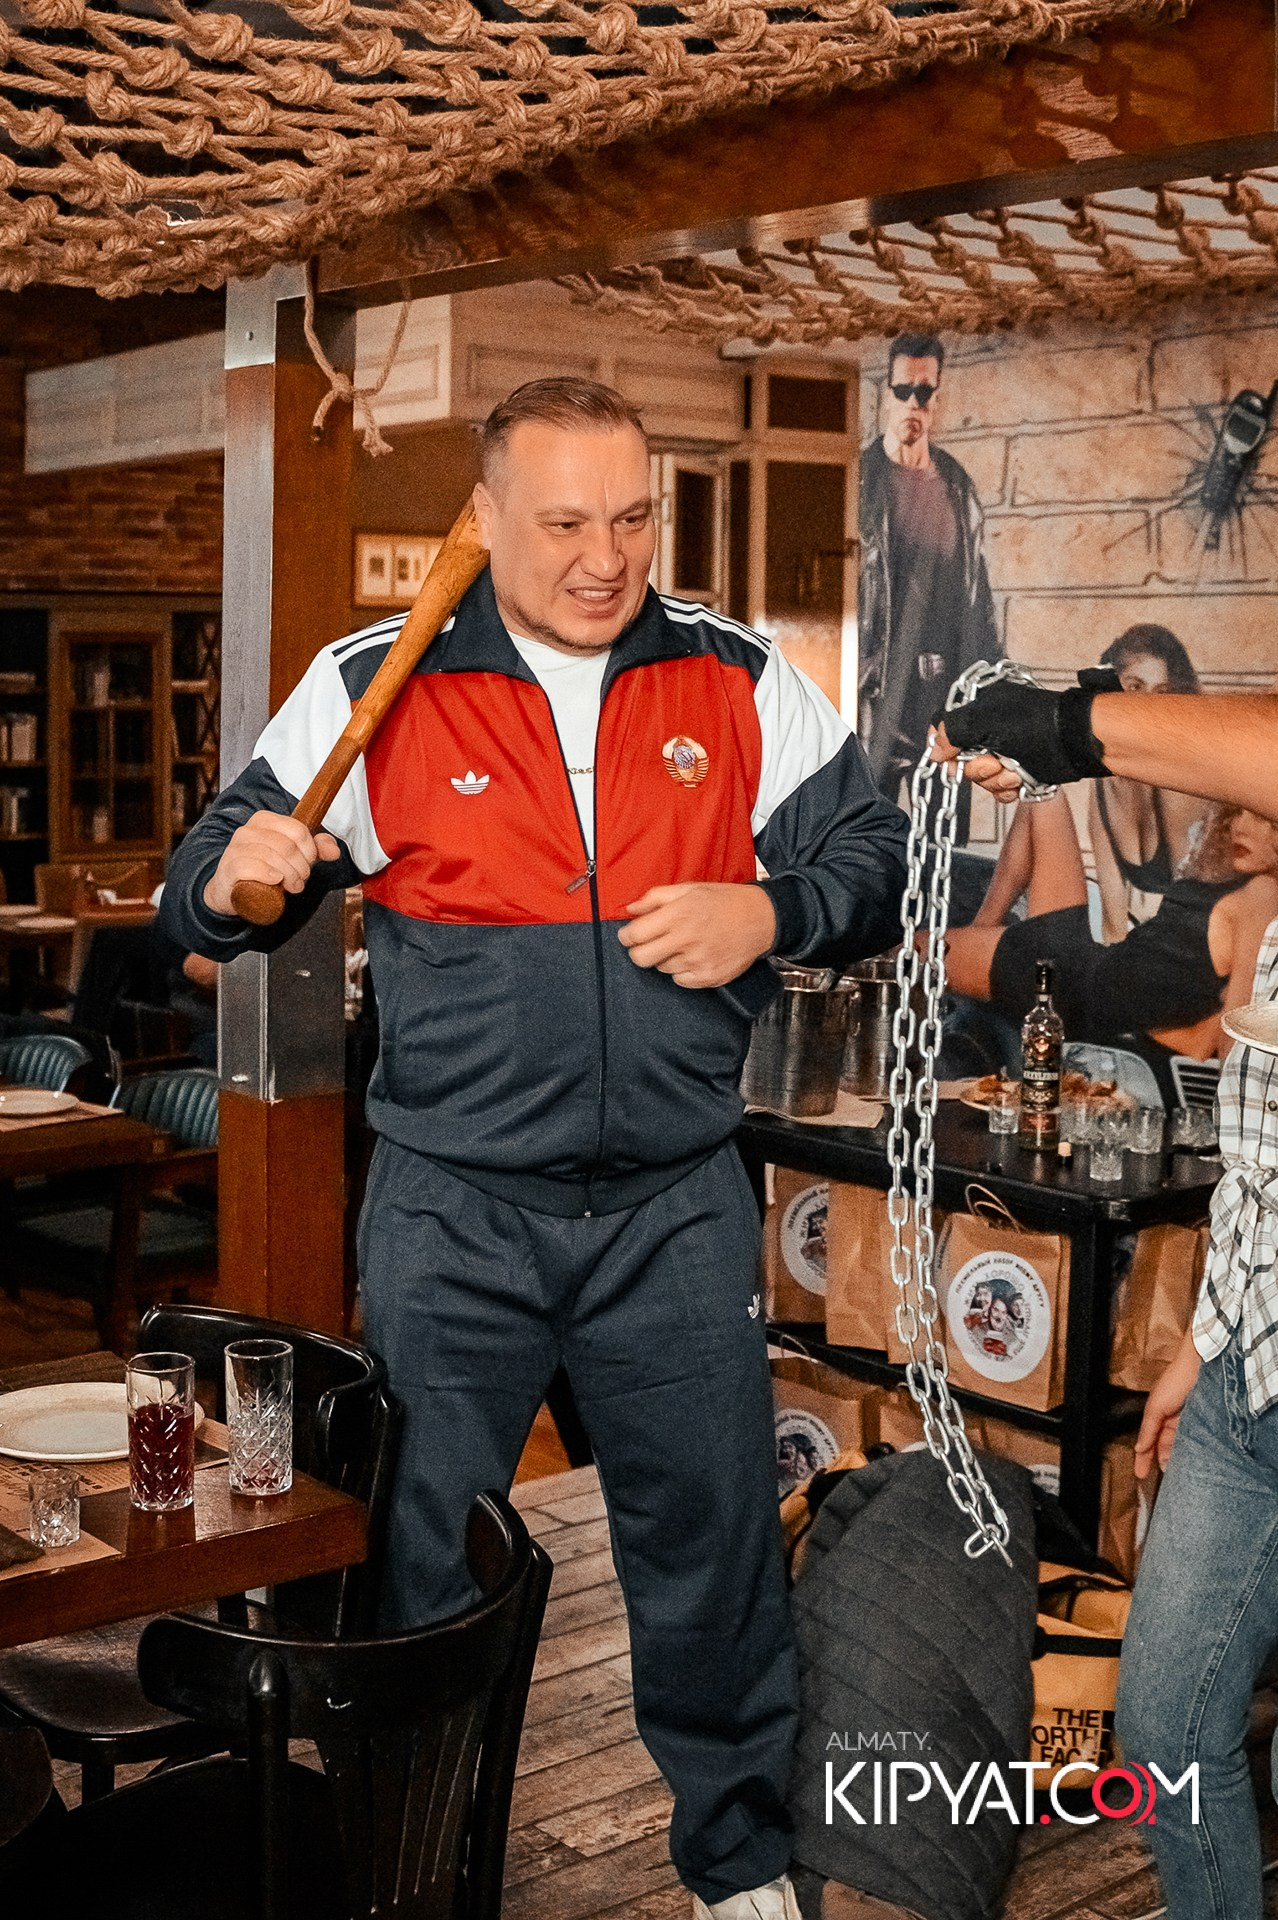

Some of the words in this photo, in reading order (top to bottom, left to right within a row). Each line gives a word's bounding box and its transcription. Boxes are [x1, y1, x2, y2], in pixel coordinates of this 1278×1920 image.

[1052, 1707, 1100, 1728] THE
[1032, 1725, 1099, 1748] ORTH
[1041, 1746, 1096, 1768] FAC
